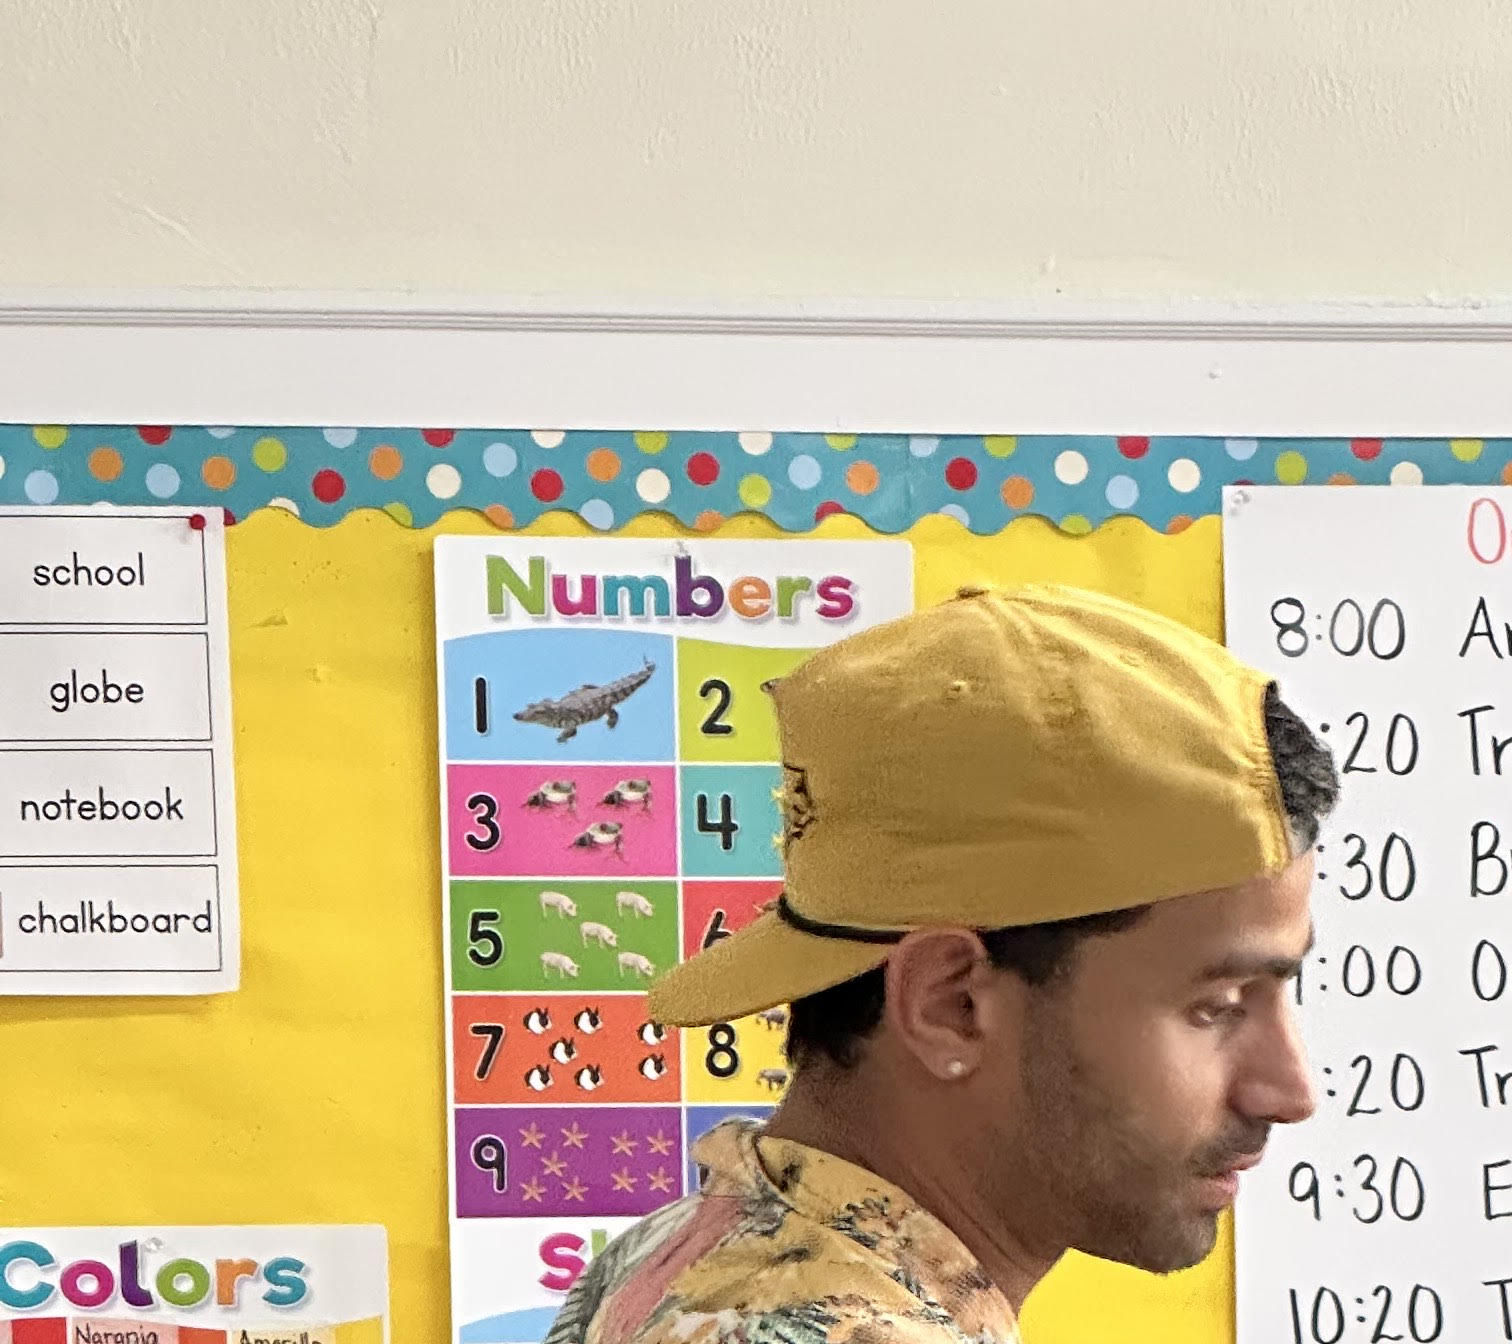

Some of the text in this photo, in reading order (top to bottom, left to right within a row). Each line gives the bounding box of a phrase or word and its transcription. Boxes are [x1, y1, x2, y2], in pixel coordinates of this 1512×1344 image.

[32, 551, 145, 587] school
[486, 554, 854, 619] Numbers
[1270, 597, 1406, 660] 8:00
[50, 669, 145, 713] globe
[475, 677, 487, 734] 1
[699, 680, 733, 735] 2
[1319, 711, 1419, 776] :20
[20, 786, 184, 822] notebook
[466, 794, 501, 852] 3
[697, 795, 738, 850] 4
[1316, 831, 1417, 902] :30
[18, 900, 212, 935] chalkboard
[468, 911, 502, 967] 5
[1296, 944, 1422, 1004] :00
[470, 1025, 504, 1079] 7
[706, 1022, 739, 1079] 8
[1322, 1053, 1425, 1118] :20
[471, 1136, 506, 1191] 9
[1289, 1154, 1426, 1225] 9:30
[0, 1239, 306, 1308] Colors
